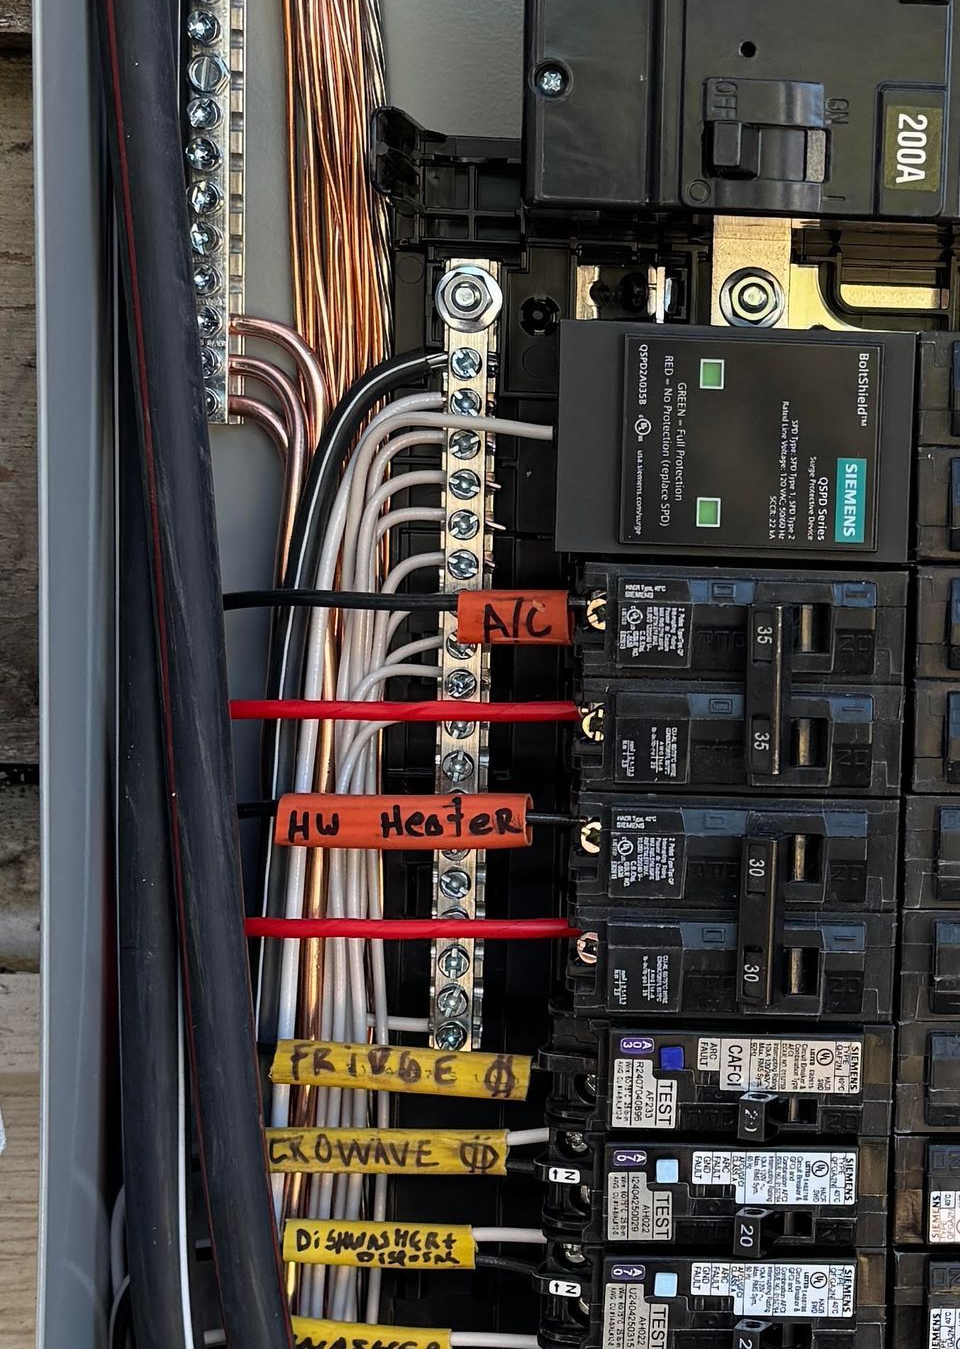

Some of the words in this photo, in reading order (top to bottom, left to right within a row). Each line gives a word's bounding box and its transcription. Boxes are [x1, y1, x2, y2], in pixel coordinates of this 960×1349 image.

[895, 113, 928, 184] 200A
[664, 355, 675, 376] RED
[663, 387, 673, 403] No
[676, 382, 687, 417] GREEN
[661, 405, 673, 457] Protection
[675, 428, 686, 448] Full
[659, 459, 672, 501] (replace
[674, 449, 686, 501] Protection
[817, 476, 829, 507] QSPD
[659, 502, 671, 527] SPD)
[843, 463, 858, 537] SIEMENS
[816, 508, 828, 541] Series
[483, 596, 553, 645] A/C
[757, 625, 773, 645] 35
[754, 731, 770, 752] 35
[288, 810, 340, 842] HW
[749, 857, 766, 878] 30
[743, 963, 759, 983] 30
[727, 1044, 743, 1087] CAFCI
[850, 1045, 862, 1091] SIEMENS
[658, 1081, 674, 1127] TEST
[655, 1195, 669, 1239] TEST
[739, 1224, 754, 1248] 20
